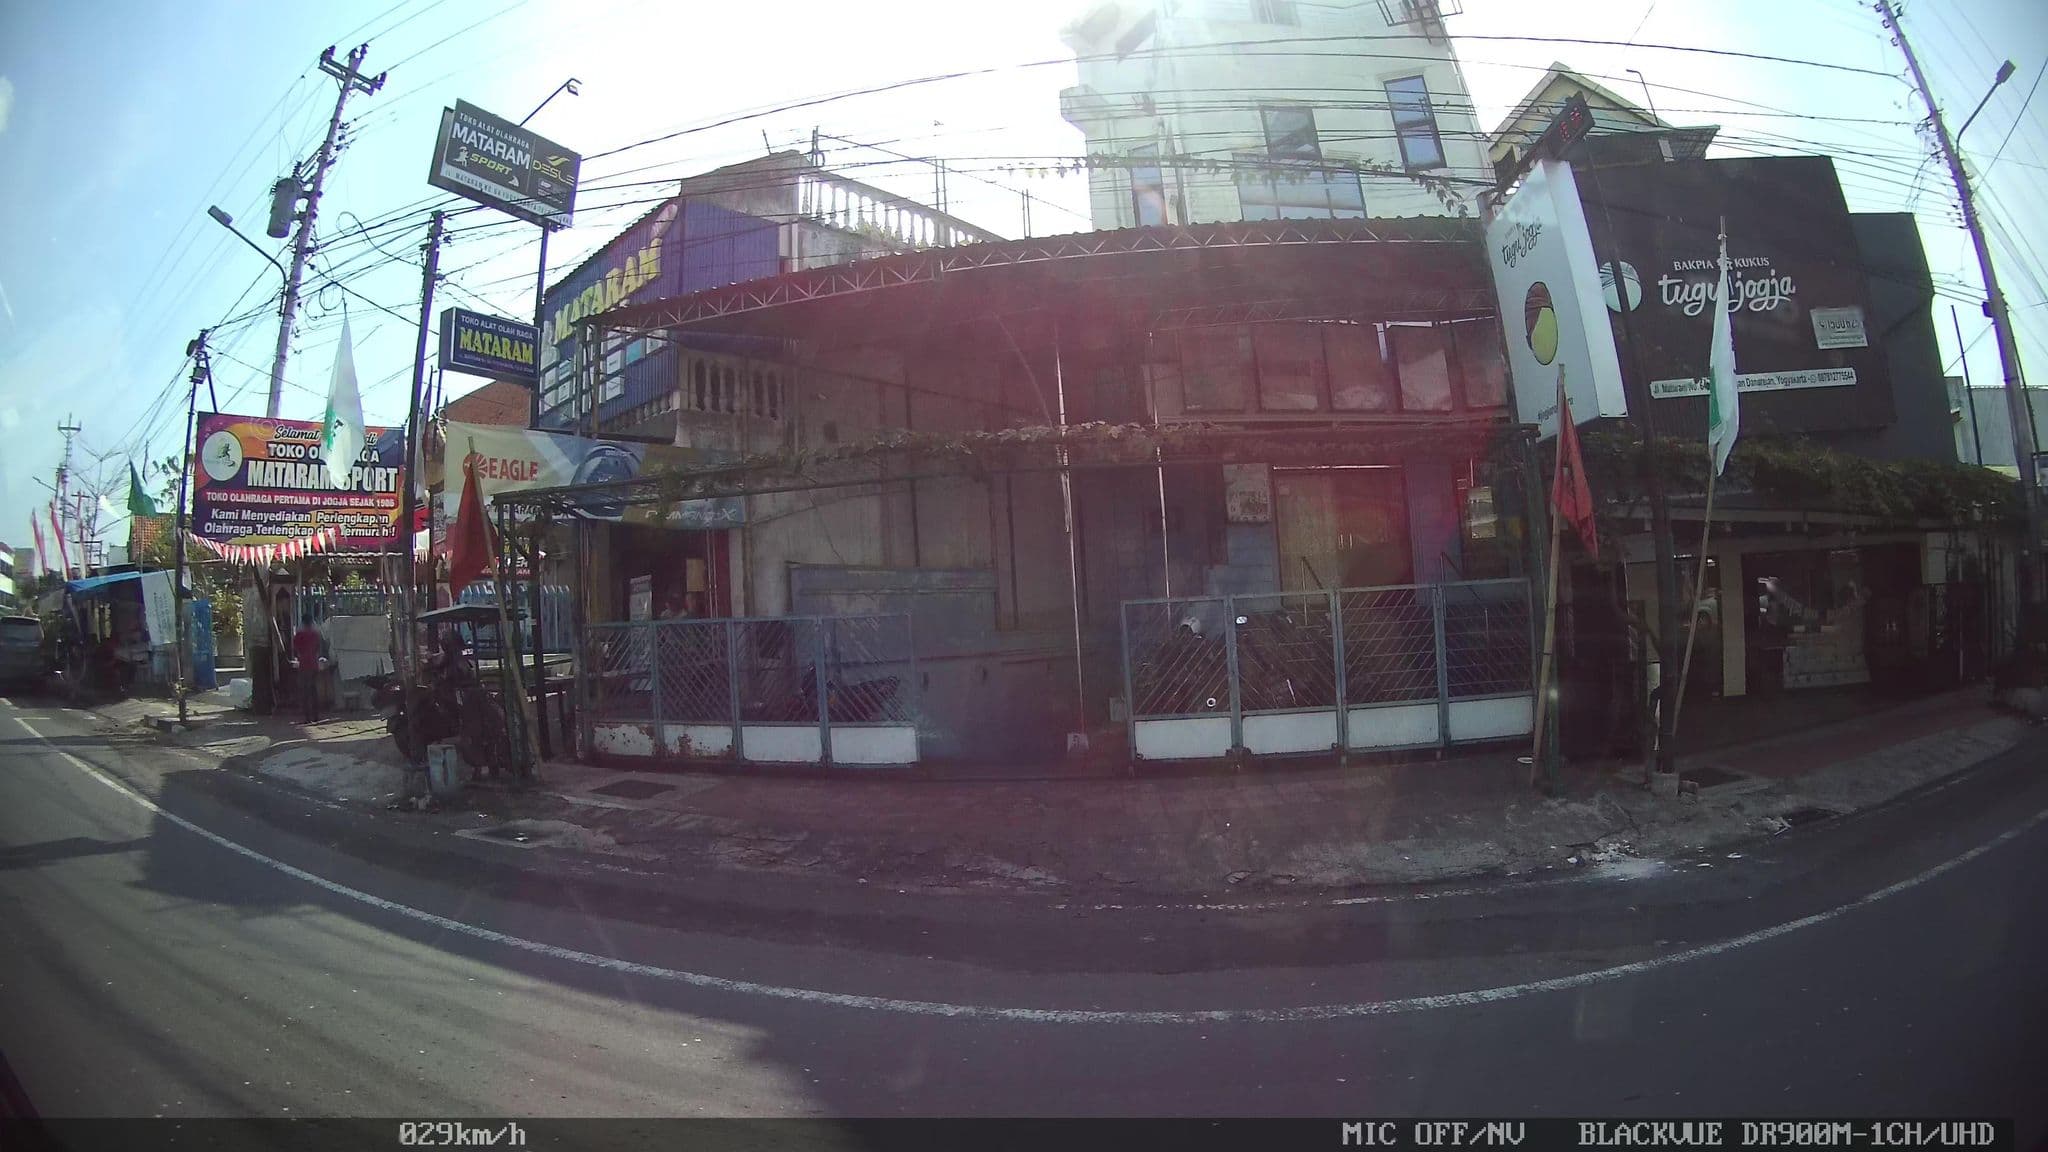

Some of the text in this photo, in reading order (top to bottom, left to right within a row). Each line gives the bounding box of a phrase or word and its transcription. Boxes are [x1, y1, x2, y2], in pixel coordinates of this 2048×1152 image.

[460, 112, 477, 125] TOKO
[478, 120, 494, 134] ALAT
[452, 122, 531, 170] MATARAM
[469, 153, 513, 175] SPORT
[1673, 257, 1770, 271] BAKPIA KUKUS
[553, 237, 662, 345] MATARAM
[1728, 269, 1796, 313] jogja
[461, 315, 479, 326] TOKO
[480, 320, 497, 330] ALAT
[460, 327, 534, 365] MATARAM
[274, 425, 320, 440] Selamat
[268, 444, 305, 460] TOKO
[248, 460, 335, 490] MATARAM
[488, 457, 539, 481] EAGLE
[206, 492, 229, 502] TOKO
[230, 493, 273, 504] OLAHRAGA
[274, 495, 310, 506] PERTAMA
[312, 496, 321, 506] DI
[322, 497, 348, 507] JOGJA
[349, 498, 374, 507] SEJAK
[211, 508, 239, 521] Kami
[241, 509, 311, 522] Menyediakan
[204, 522, 253, 536] Olahraga
[256, 524, 314, 537] Terlengkap
